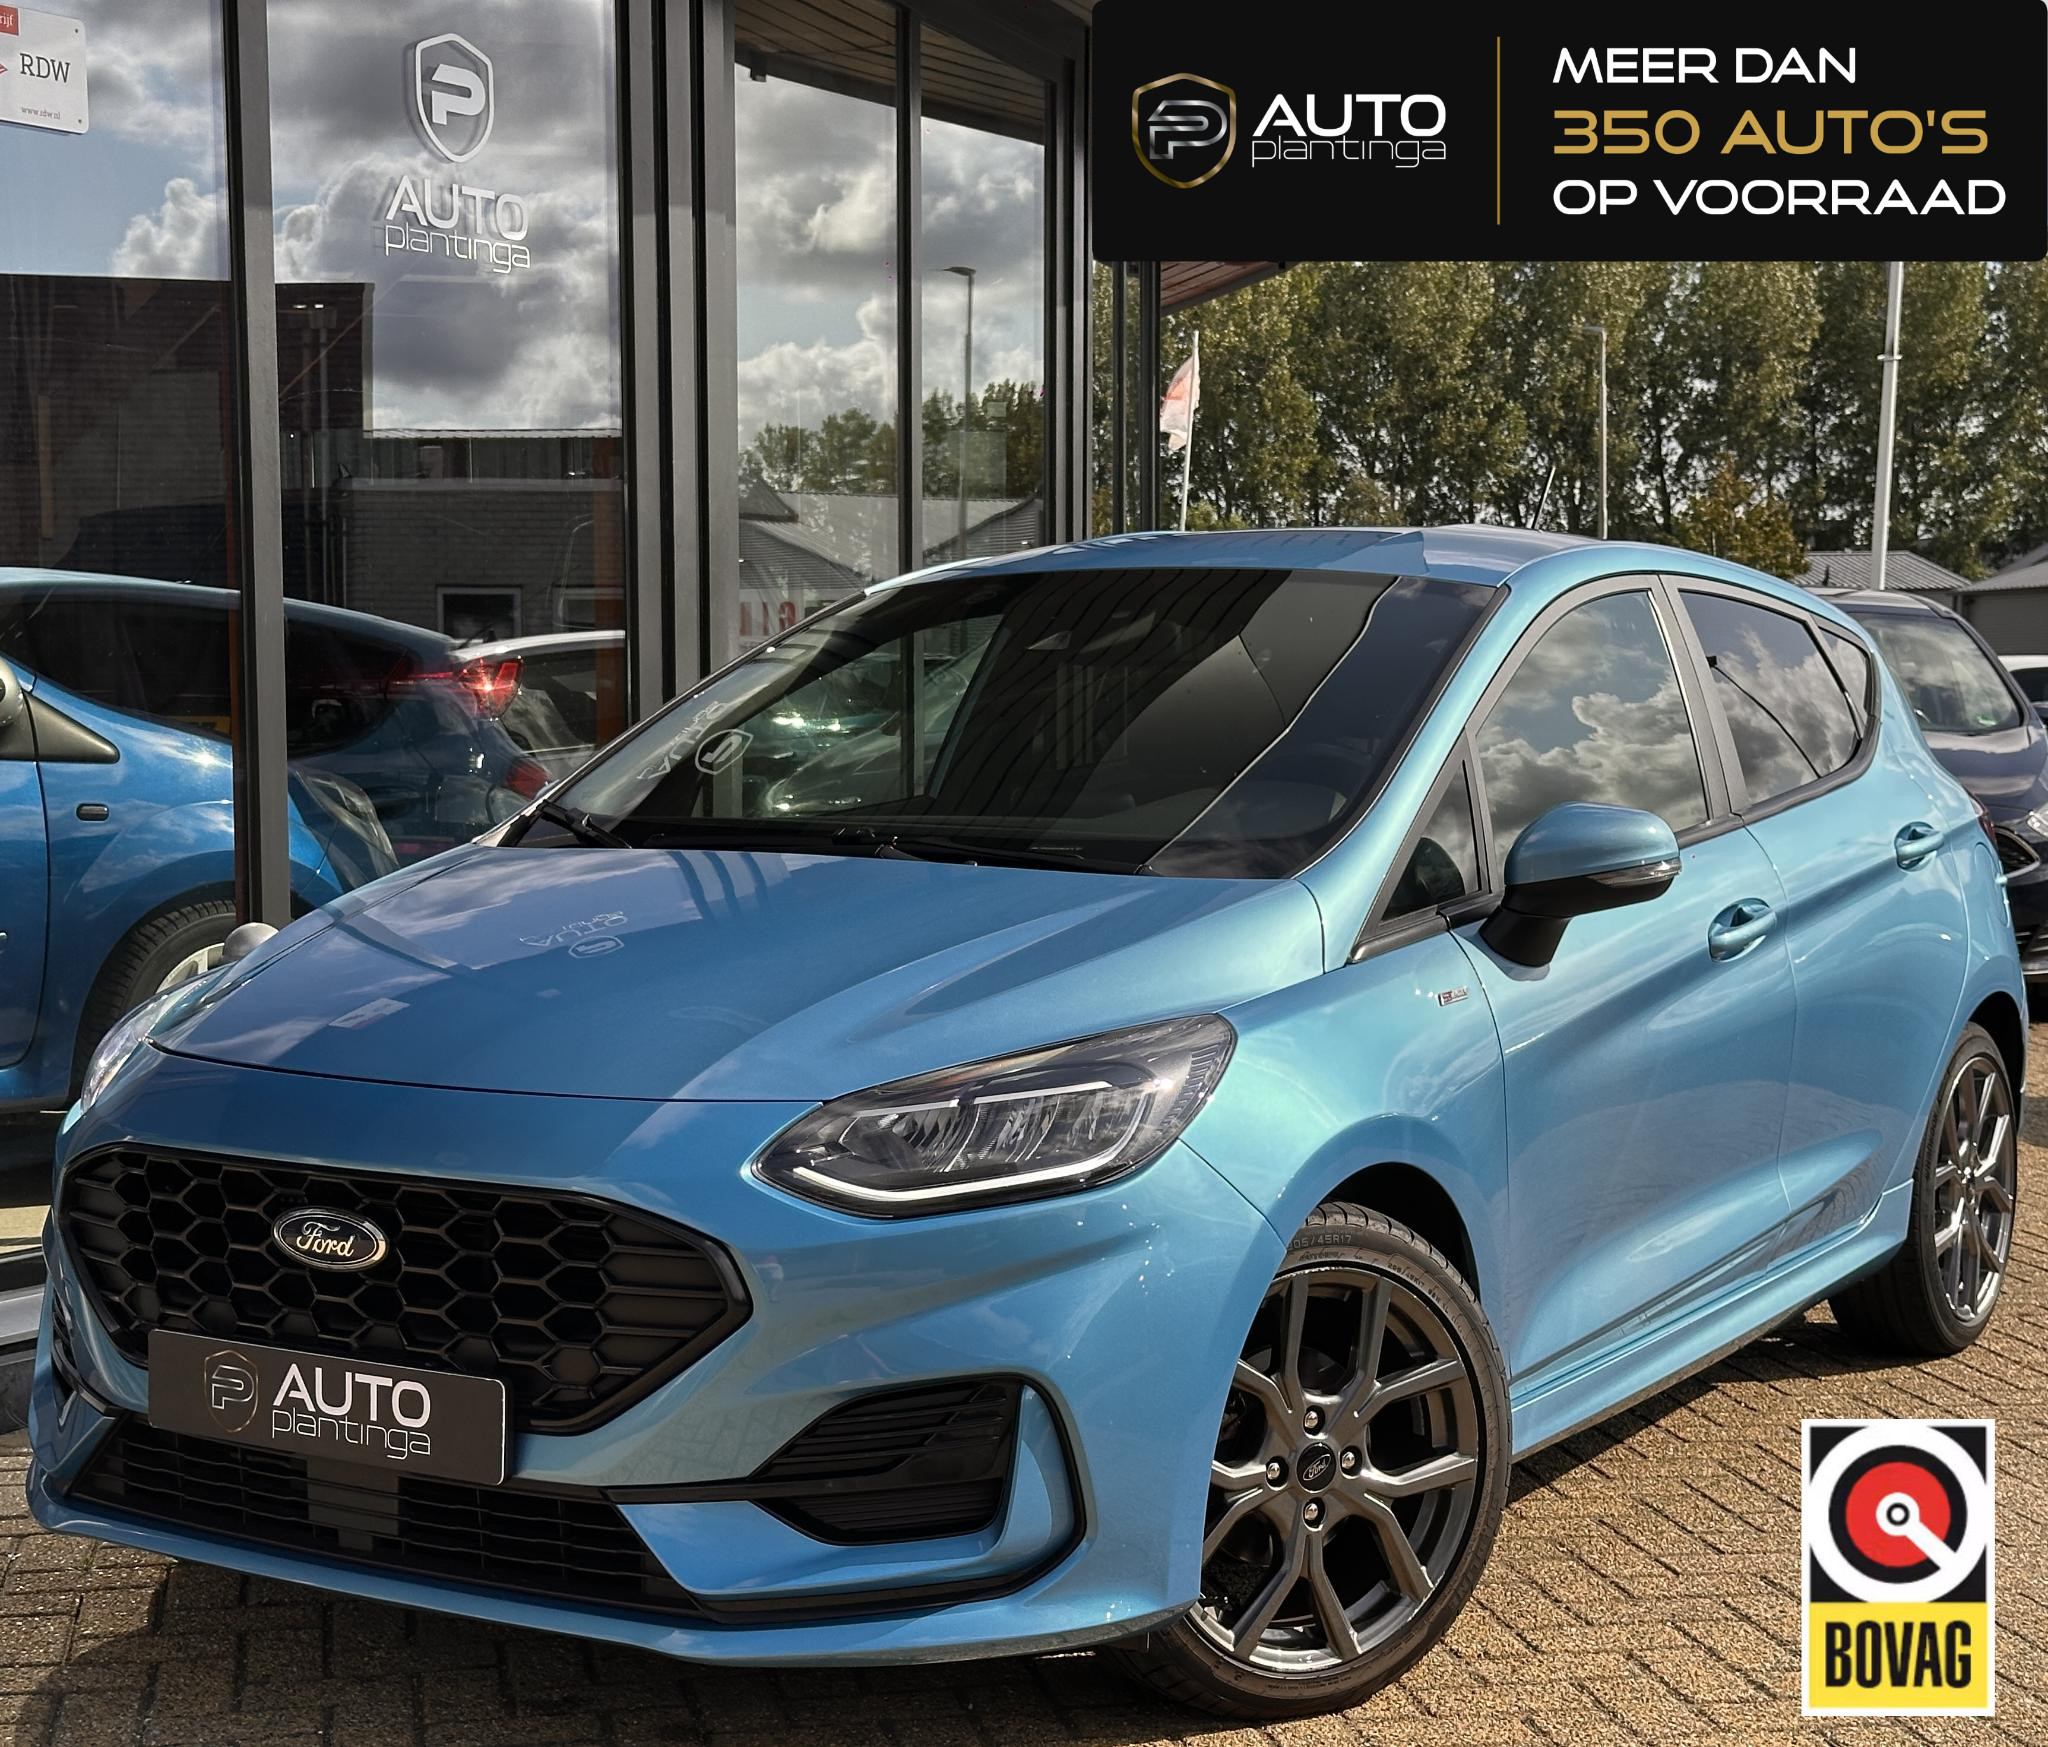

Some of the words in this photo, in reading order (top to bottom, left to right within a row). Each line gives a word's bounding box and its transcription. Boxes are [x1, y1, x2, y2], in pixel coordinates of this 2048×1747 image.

[20, 53, 71, 83] RDW
[385, 175, 529, 241] AUTO
[385, 223, 531, 274] plantinga
[296, 1221, 356, 1257] Ford
[272, 1363, 432, 1428] AUTO
[271, 1407, 432, 1460] plantinga
